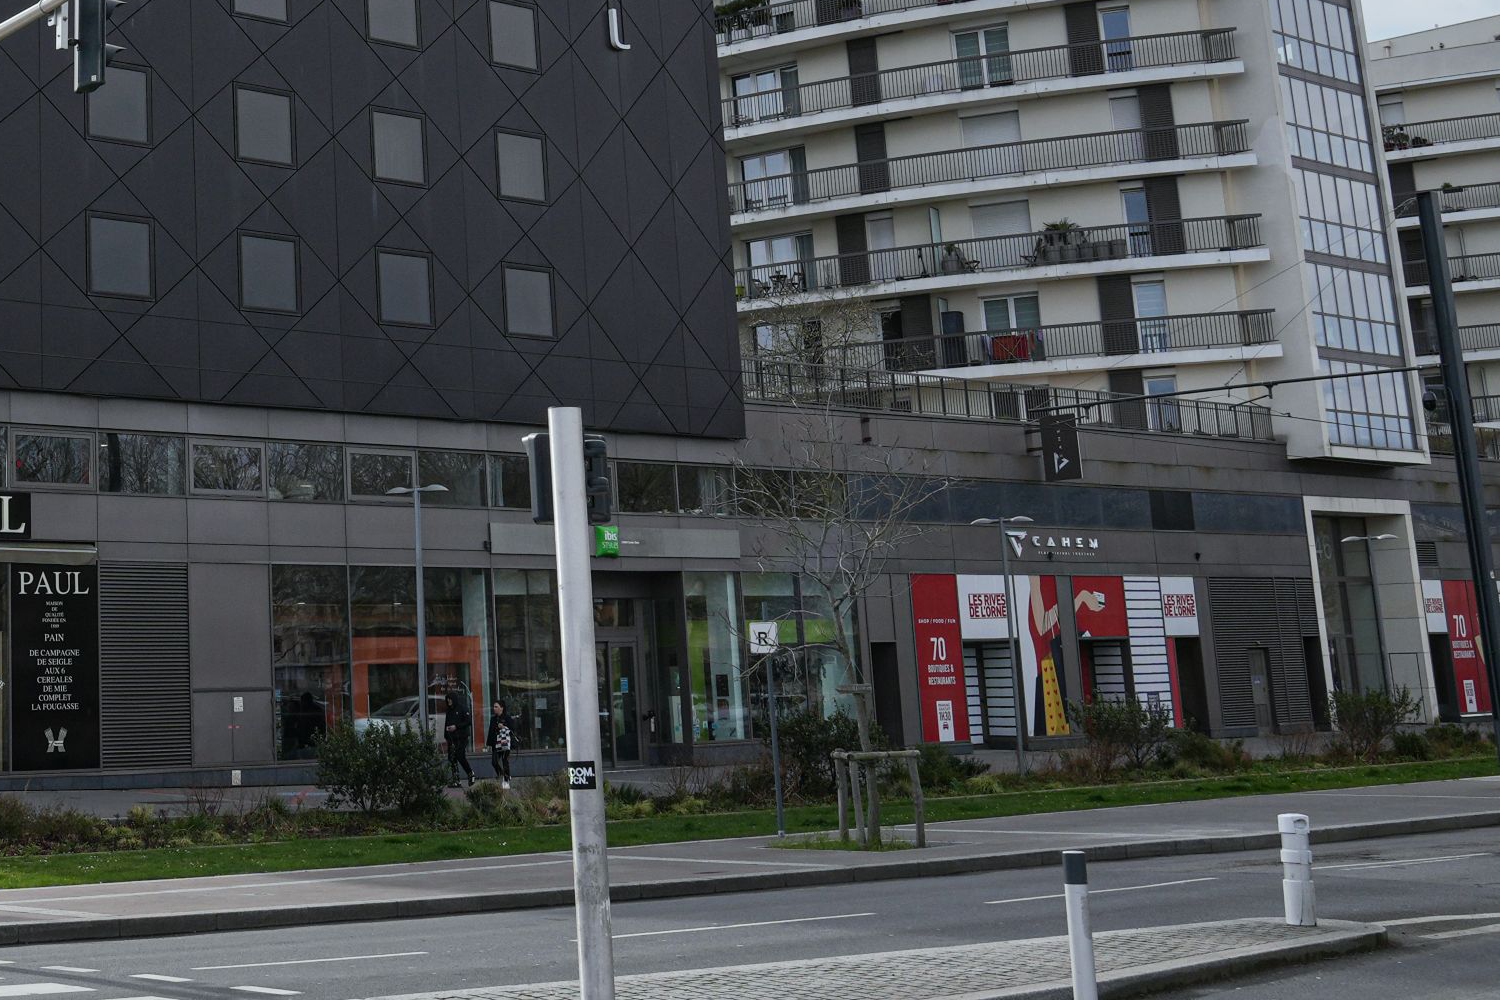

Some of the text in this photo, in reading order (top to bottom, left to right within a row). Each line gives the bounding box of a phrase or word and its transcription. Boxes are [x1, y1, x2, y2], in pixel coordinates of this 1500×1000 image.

[604, 530, 618, 541] ibis
[18, 571, 90, 595] PAUL
[968, 594, 1006, 606] LES RIVES
[1163, 595, 1195, 605] LES RIVES
[970, 605, 1007, 617] DE L'ORNE
[1164, 605, 1195, 616] DE L'ORNE
[1453, 614, 1467, 638] 70
[44, 633, 65, 642] PAIN
[757, 631, 768, 646] R
[29, 649, 80, 657] DE CAMPAGNE
[930, 637, 947, 661] 70
[44, 667, 60, 675] AUX
[928, 664, 950, 673] BOUTIQUES
[928, 676, 956, 685] RESTAURANTS
[38, 694, 72, 702] COMPLET
[31, 703, 80, 711] LA FOUGASSE
